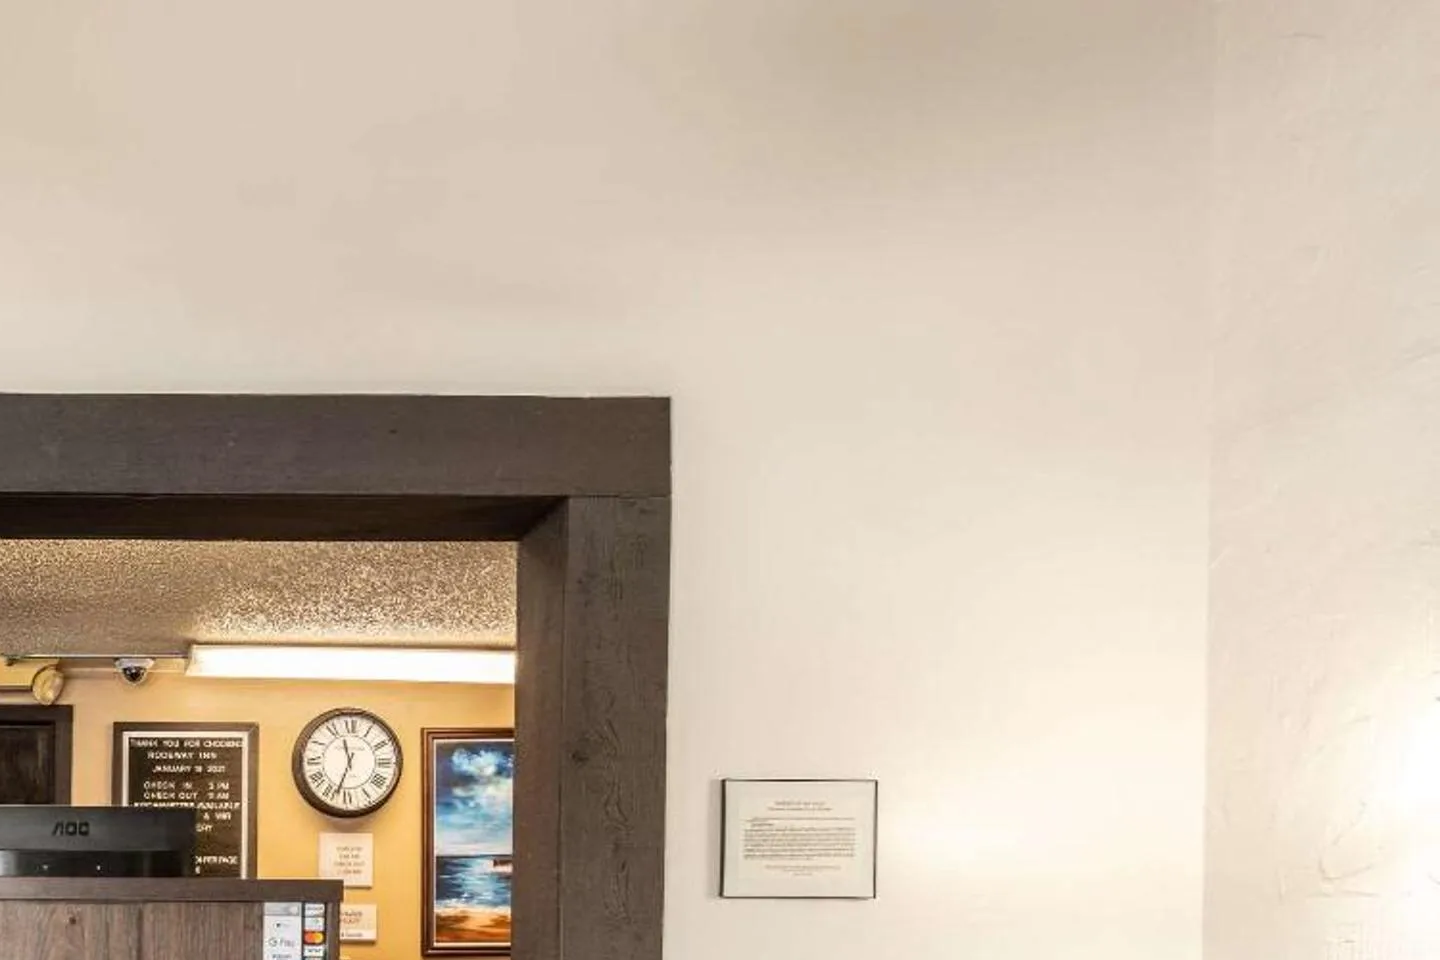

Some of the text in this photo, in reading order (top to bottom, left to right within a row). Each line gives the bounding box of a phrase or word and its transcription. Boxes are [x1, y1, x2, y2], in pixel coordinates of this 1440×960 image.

[163, 739, 180, 748] YOU
[183, 739, 201, 748] FOR
[143, 781, 176, 790] CHECK
[143, 791, 176, 800] CHECK
[178, 791, 199, 800] OUT
[216, 791, 230, 800] AM
